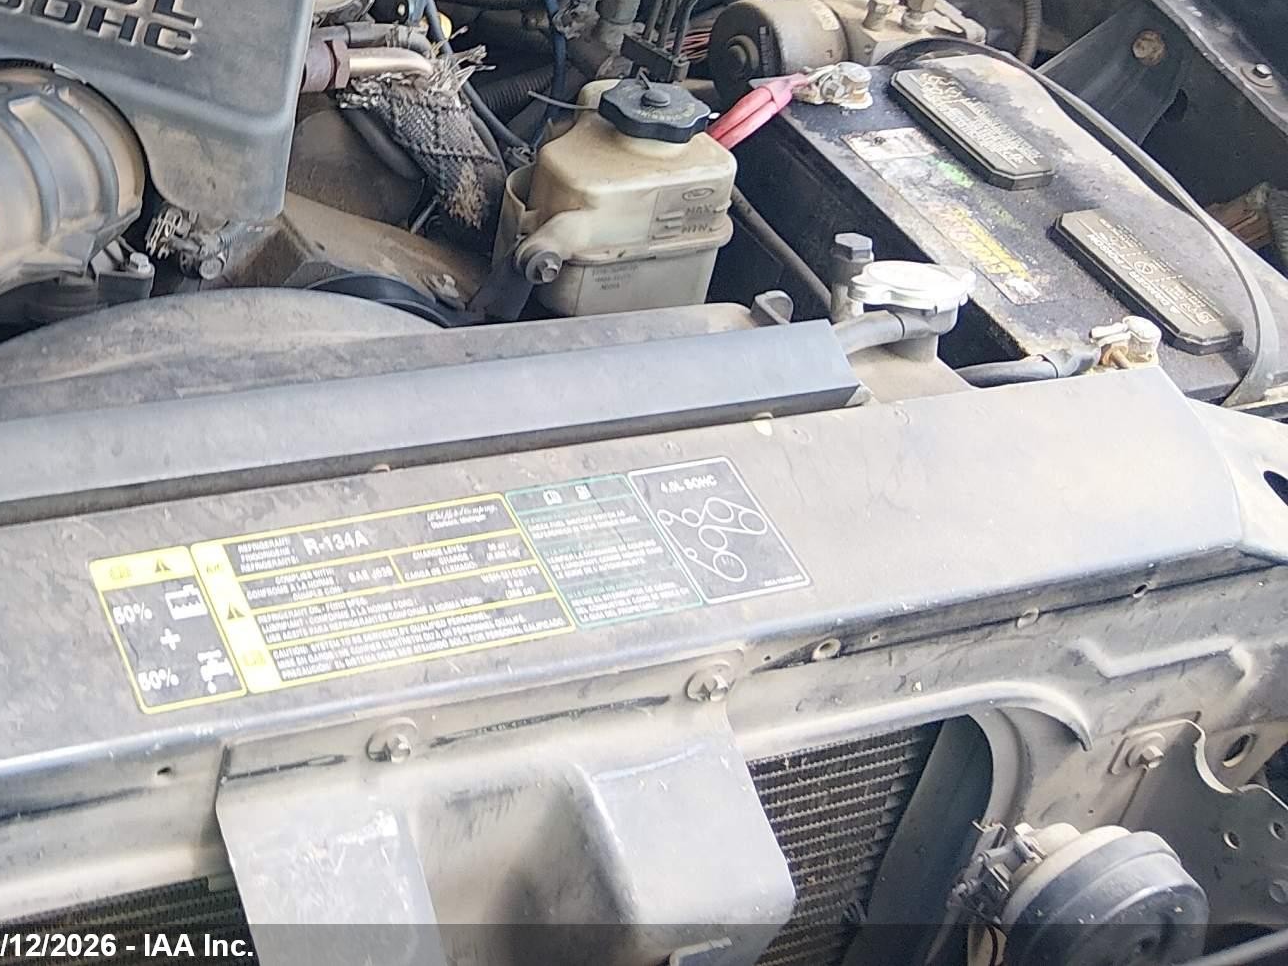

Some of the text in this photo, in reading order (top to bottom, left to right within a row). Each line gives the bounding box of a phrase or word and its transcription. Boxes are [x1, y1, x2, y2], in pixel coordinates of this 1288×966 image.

[685, 204, 713, 217] MAX
[681, 223, 709, 234] MIN
[686, 474, 718, 491] SOHC
[303, 530, 369, 555] R-134A
[112, 602, 153, 625] 50%
[138, 667, 180, 692] 50%
